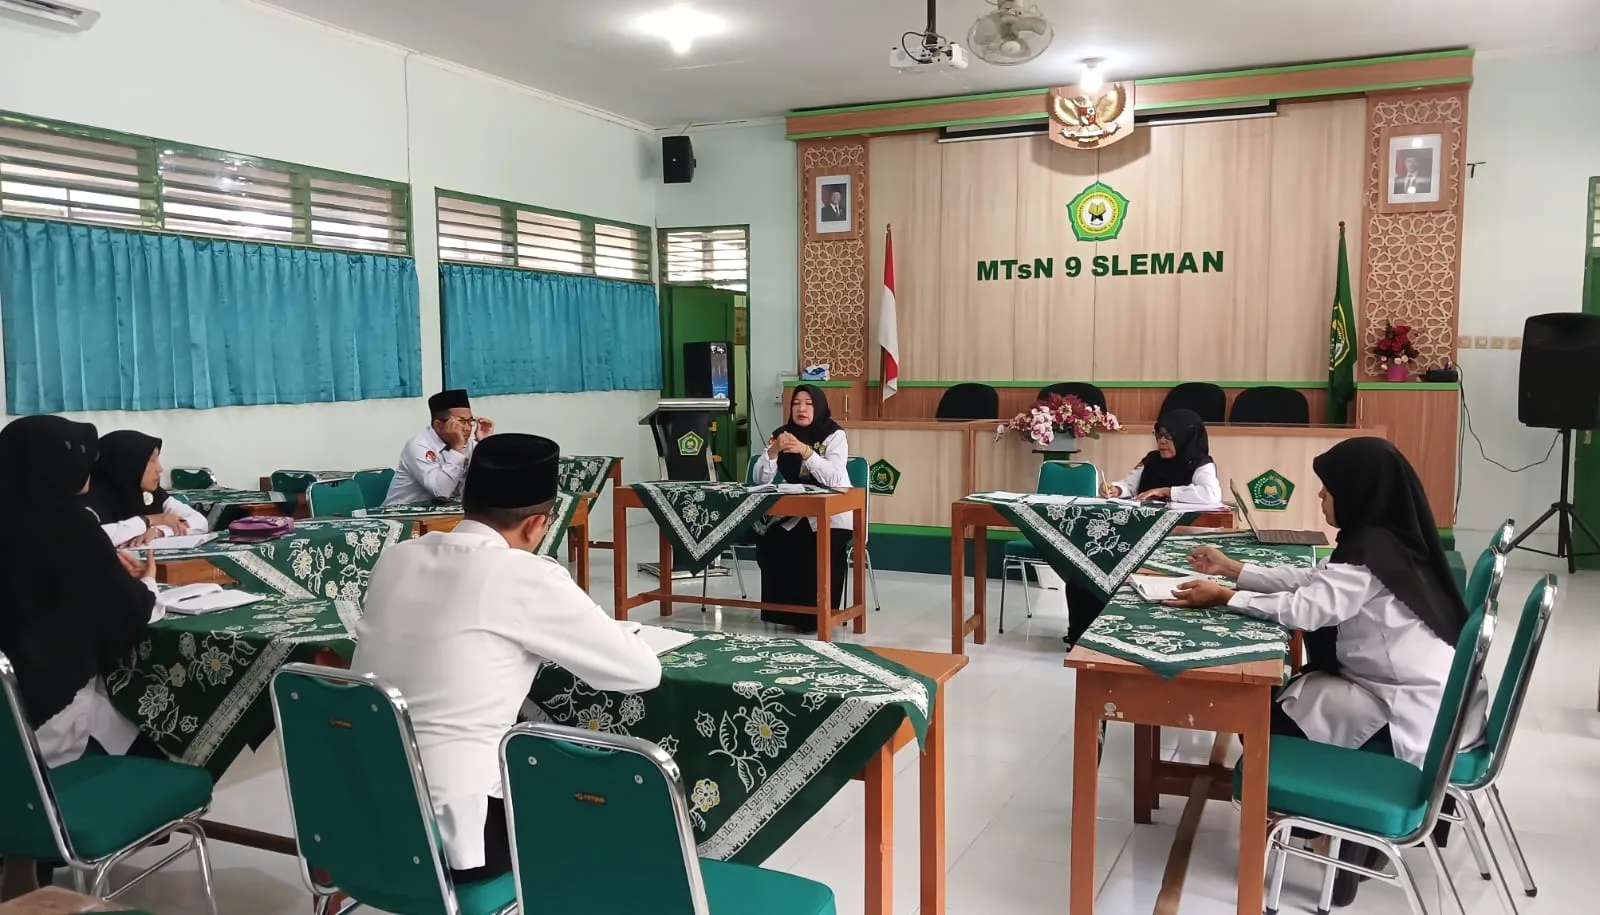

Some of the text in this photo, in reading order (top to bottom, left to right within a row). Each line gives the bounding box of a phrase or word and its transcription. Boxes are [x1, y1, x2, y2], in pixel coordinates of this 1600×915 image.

[977, 250, 1224, 281] MTsN 9 SLEMAN
